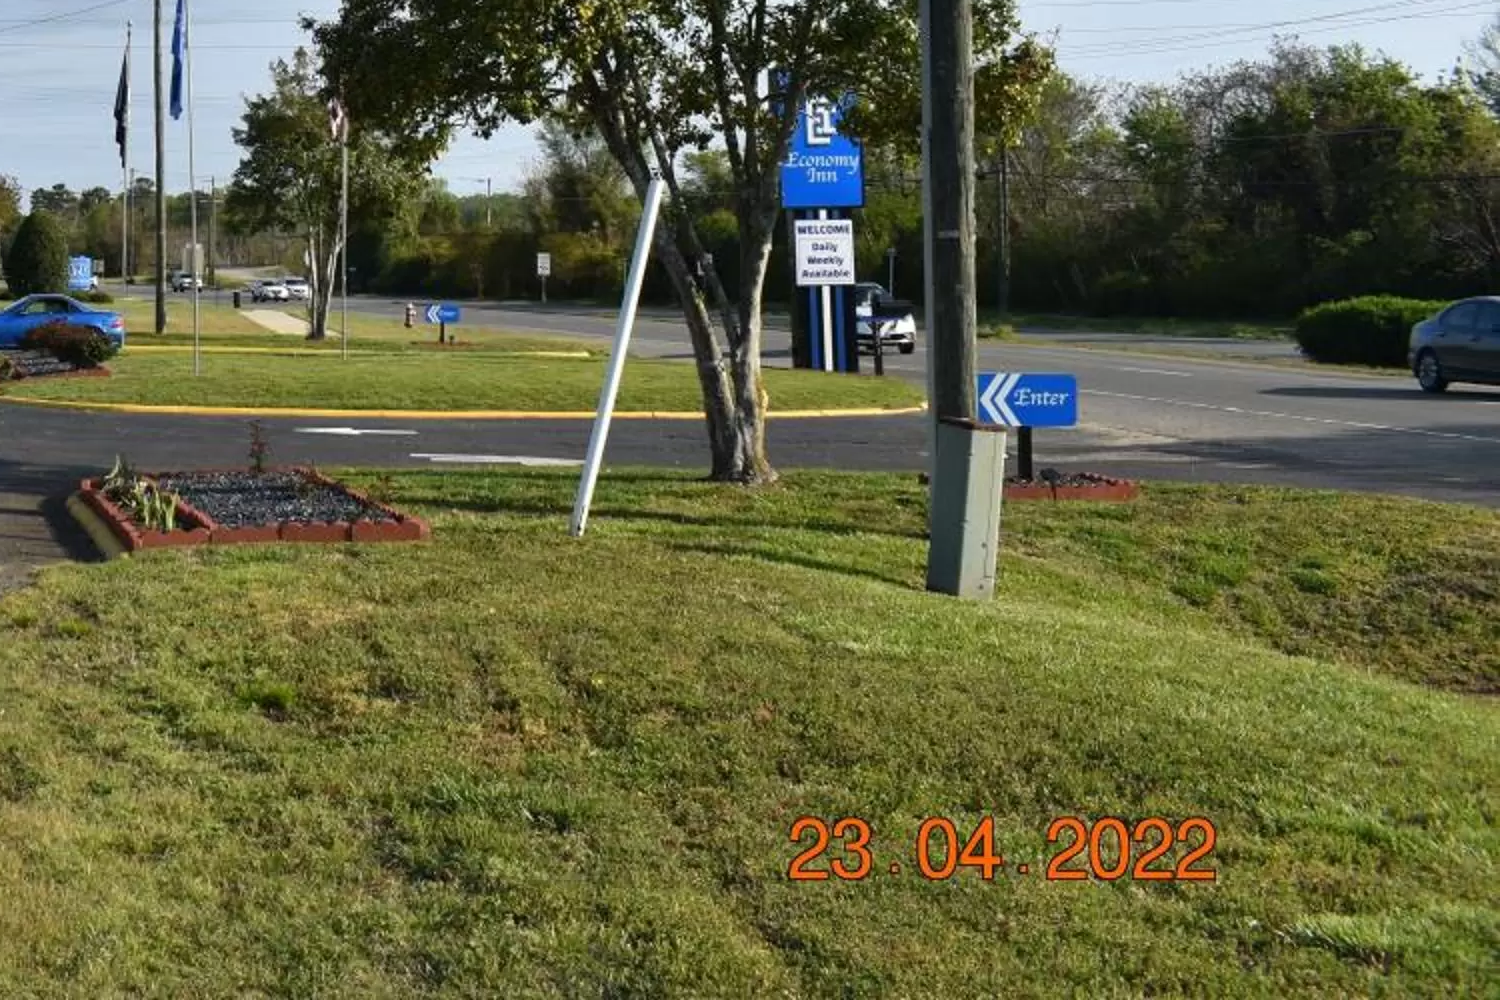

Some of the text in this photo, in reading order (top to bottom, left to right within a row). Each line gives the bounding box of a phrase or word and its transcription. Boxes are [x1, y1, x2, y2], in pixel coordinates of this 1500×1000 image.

[784, 151, 860, 175] Economy
[806, 167, 838, 183] Inn
[797, 225, 850, 235] WELCOME
[811, 242, 838, 253] Daily
[806, 256, 844, 267] Weekly
[801, 269, 851, 278] Available
[1013, 387, 1069, 407] Enter
